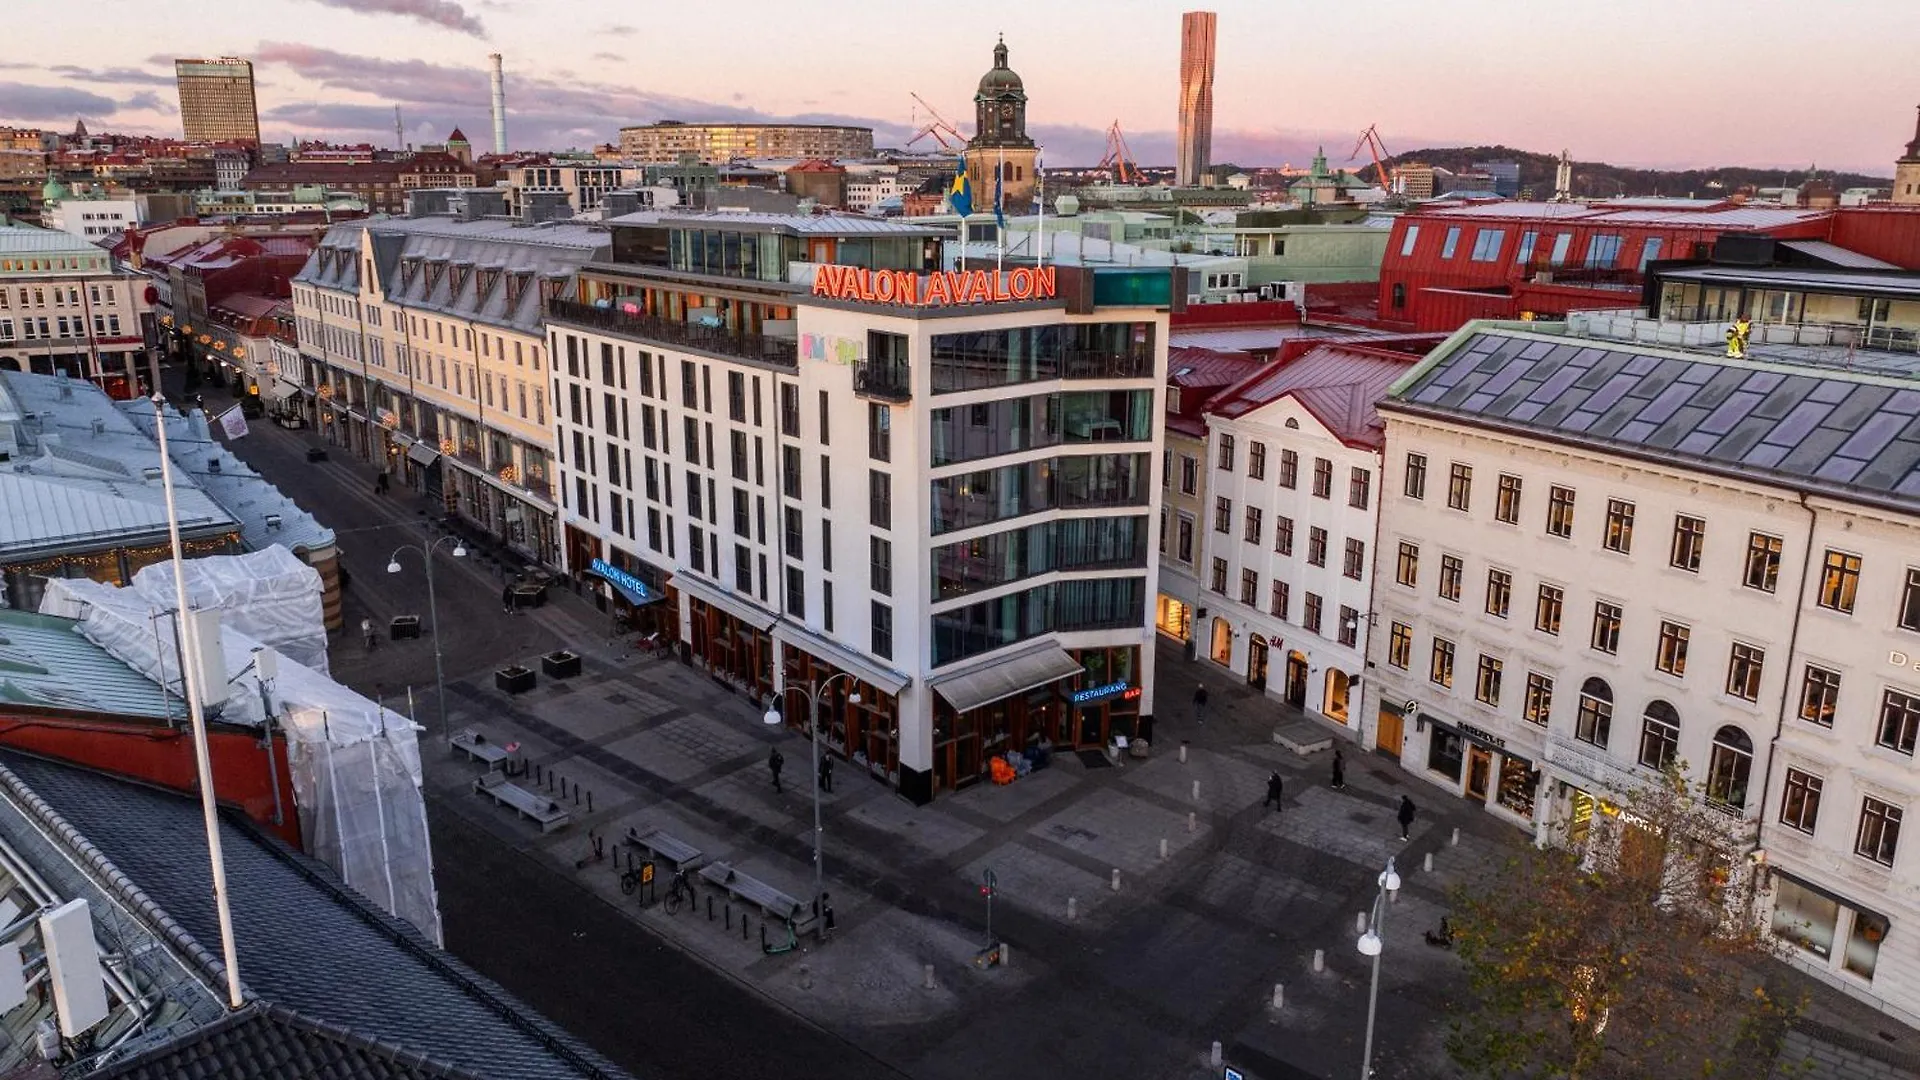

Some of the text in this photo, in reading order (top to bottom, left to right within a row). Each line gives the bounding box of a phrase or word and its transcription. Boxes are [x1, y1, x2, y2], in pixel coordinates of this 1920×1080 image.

[813, 264, 1056, 304] AVALON AVALON
[621, 574, 646, 597] HOTEL
[1074, 681, 1140, 702] RESTAURANG BAR
